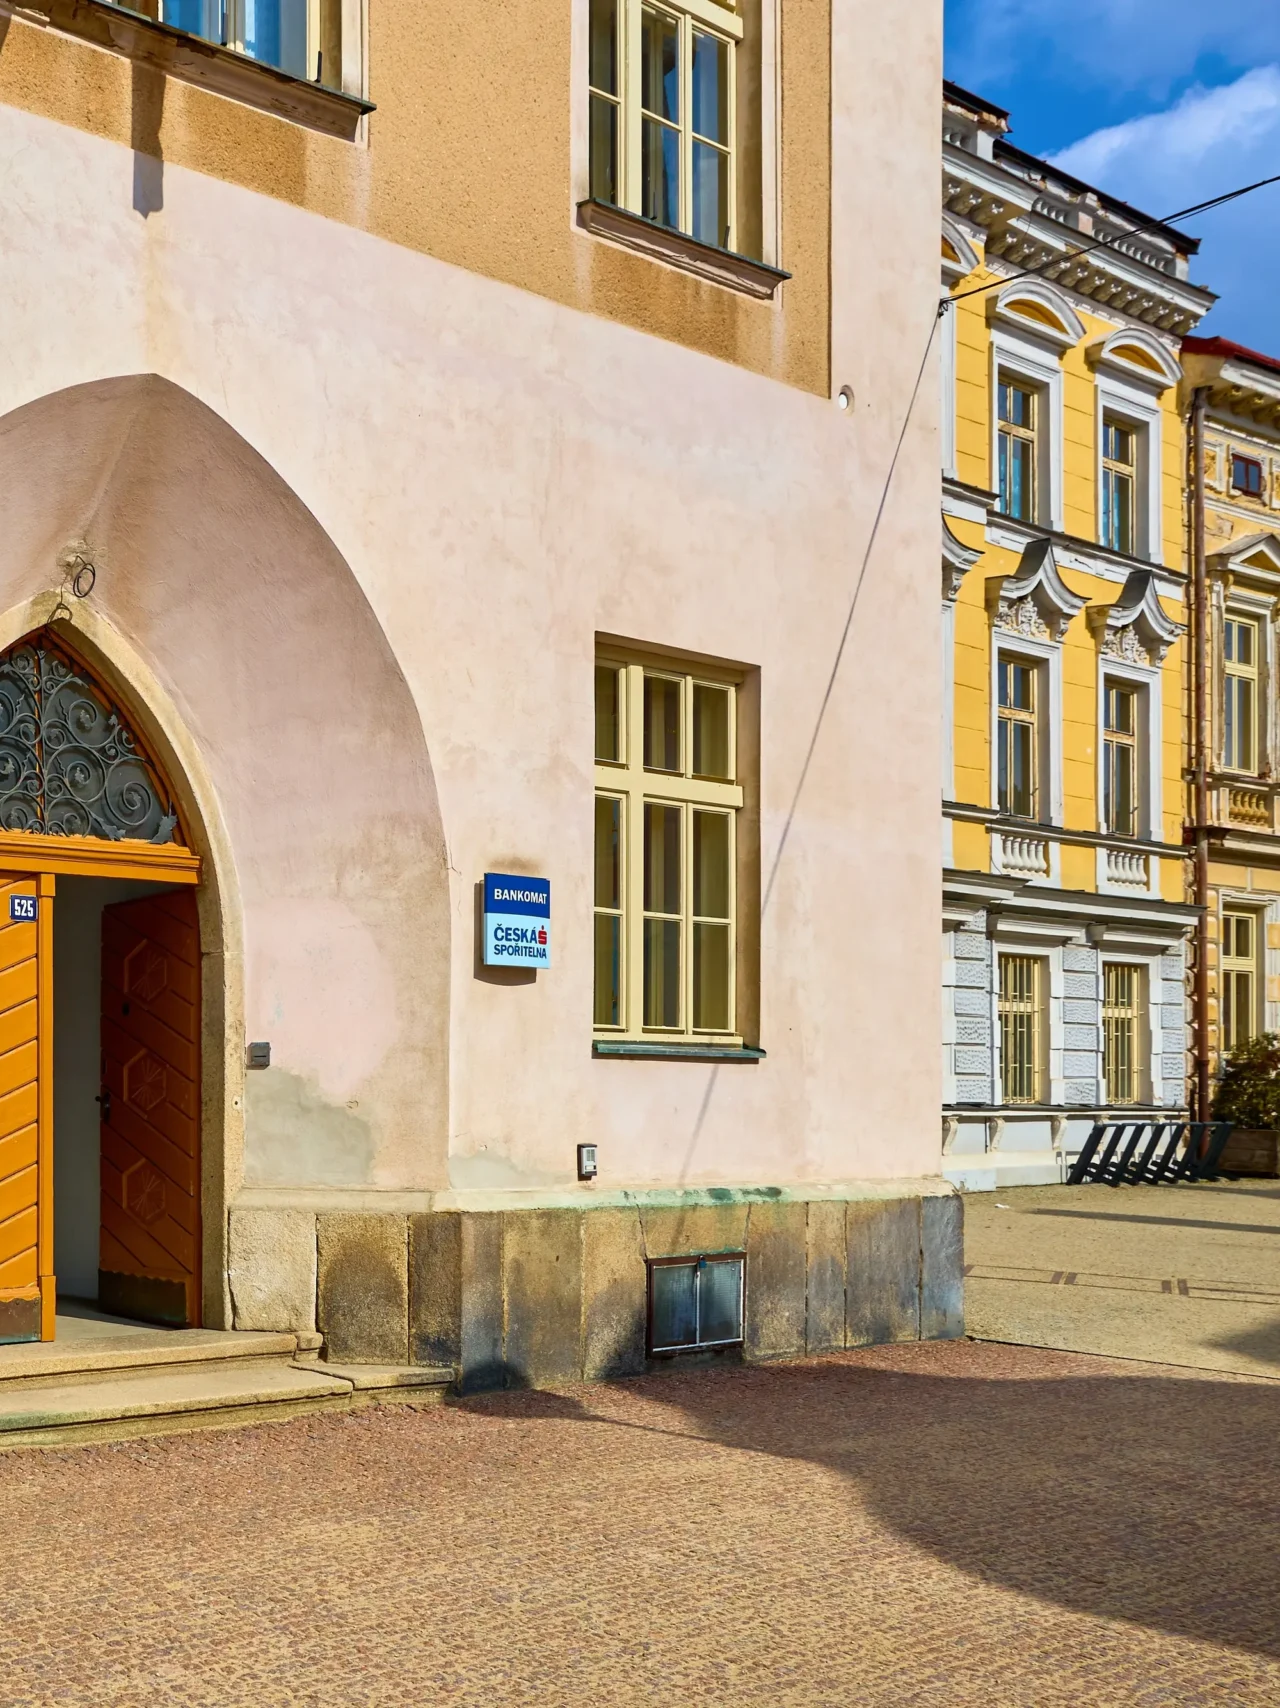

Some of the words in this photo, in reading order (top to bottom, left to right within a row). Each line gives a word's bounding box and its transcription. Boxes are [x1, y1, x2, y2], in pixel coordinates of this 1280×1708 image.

[494, 888, 548, 905] BANKOMAT
[14, 898, 34, 917] 525
[493, 923, 538, 944] ČESKÁ
[493, 943, 548, 959] SPOŘITELNA
